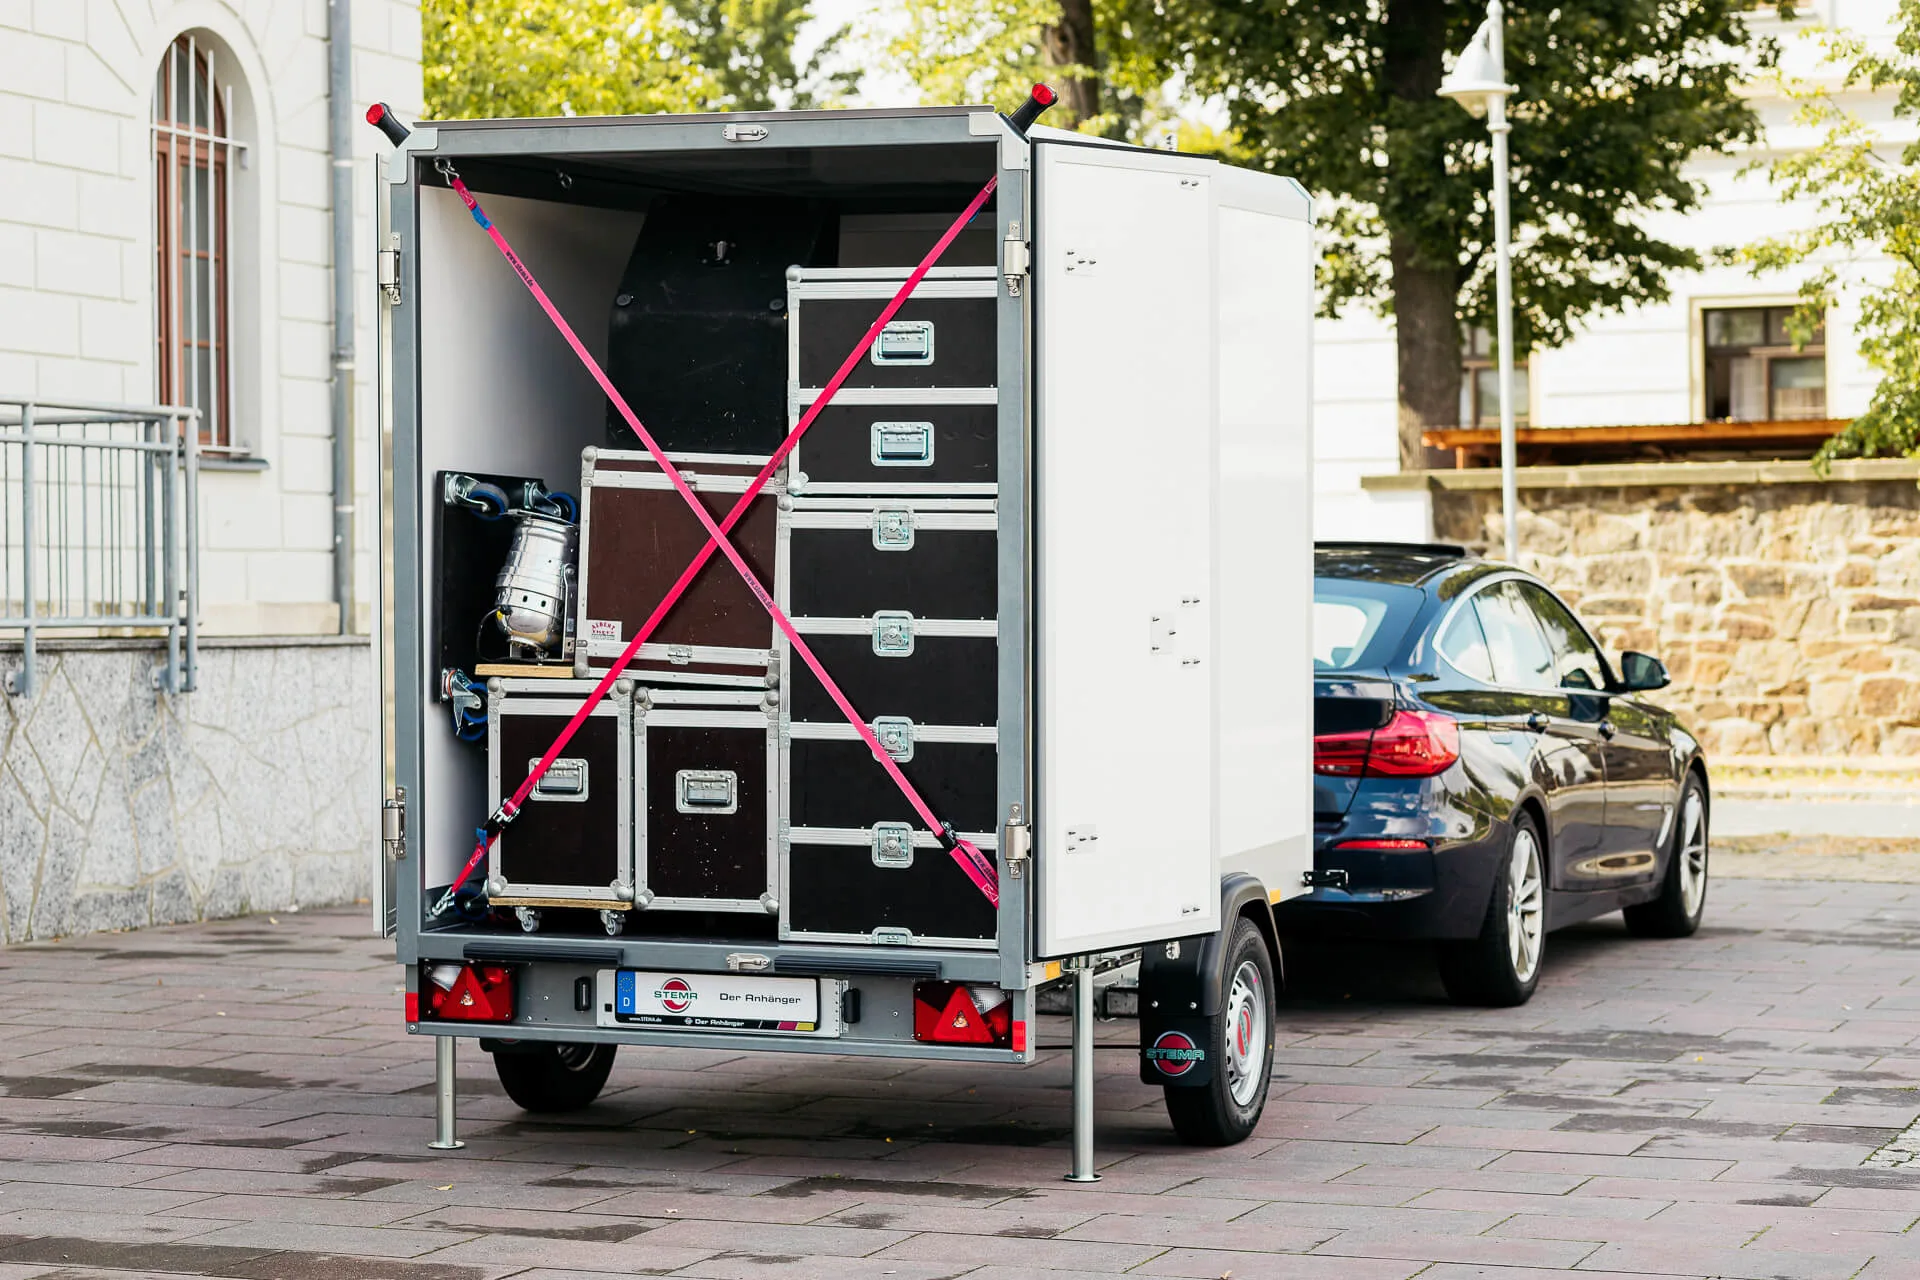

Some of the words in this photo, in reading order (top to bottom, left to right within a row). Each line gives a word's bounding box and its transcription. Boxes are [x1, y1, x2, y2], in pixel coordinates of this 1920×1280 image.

[654, 990, 698, 1000] STEMA
[720, 993, 741, 1001] Der
[745, 994, 801, 1005] Anhänger
[623, 997, 631, 1007] D
[710, 1019, 745, 1027] Anhänger
[1146, 1048, 1205, 1060] STEMA
